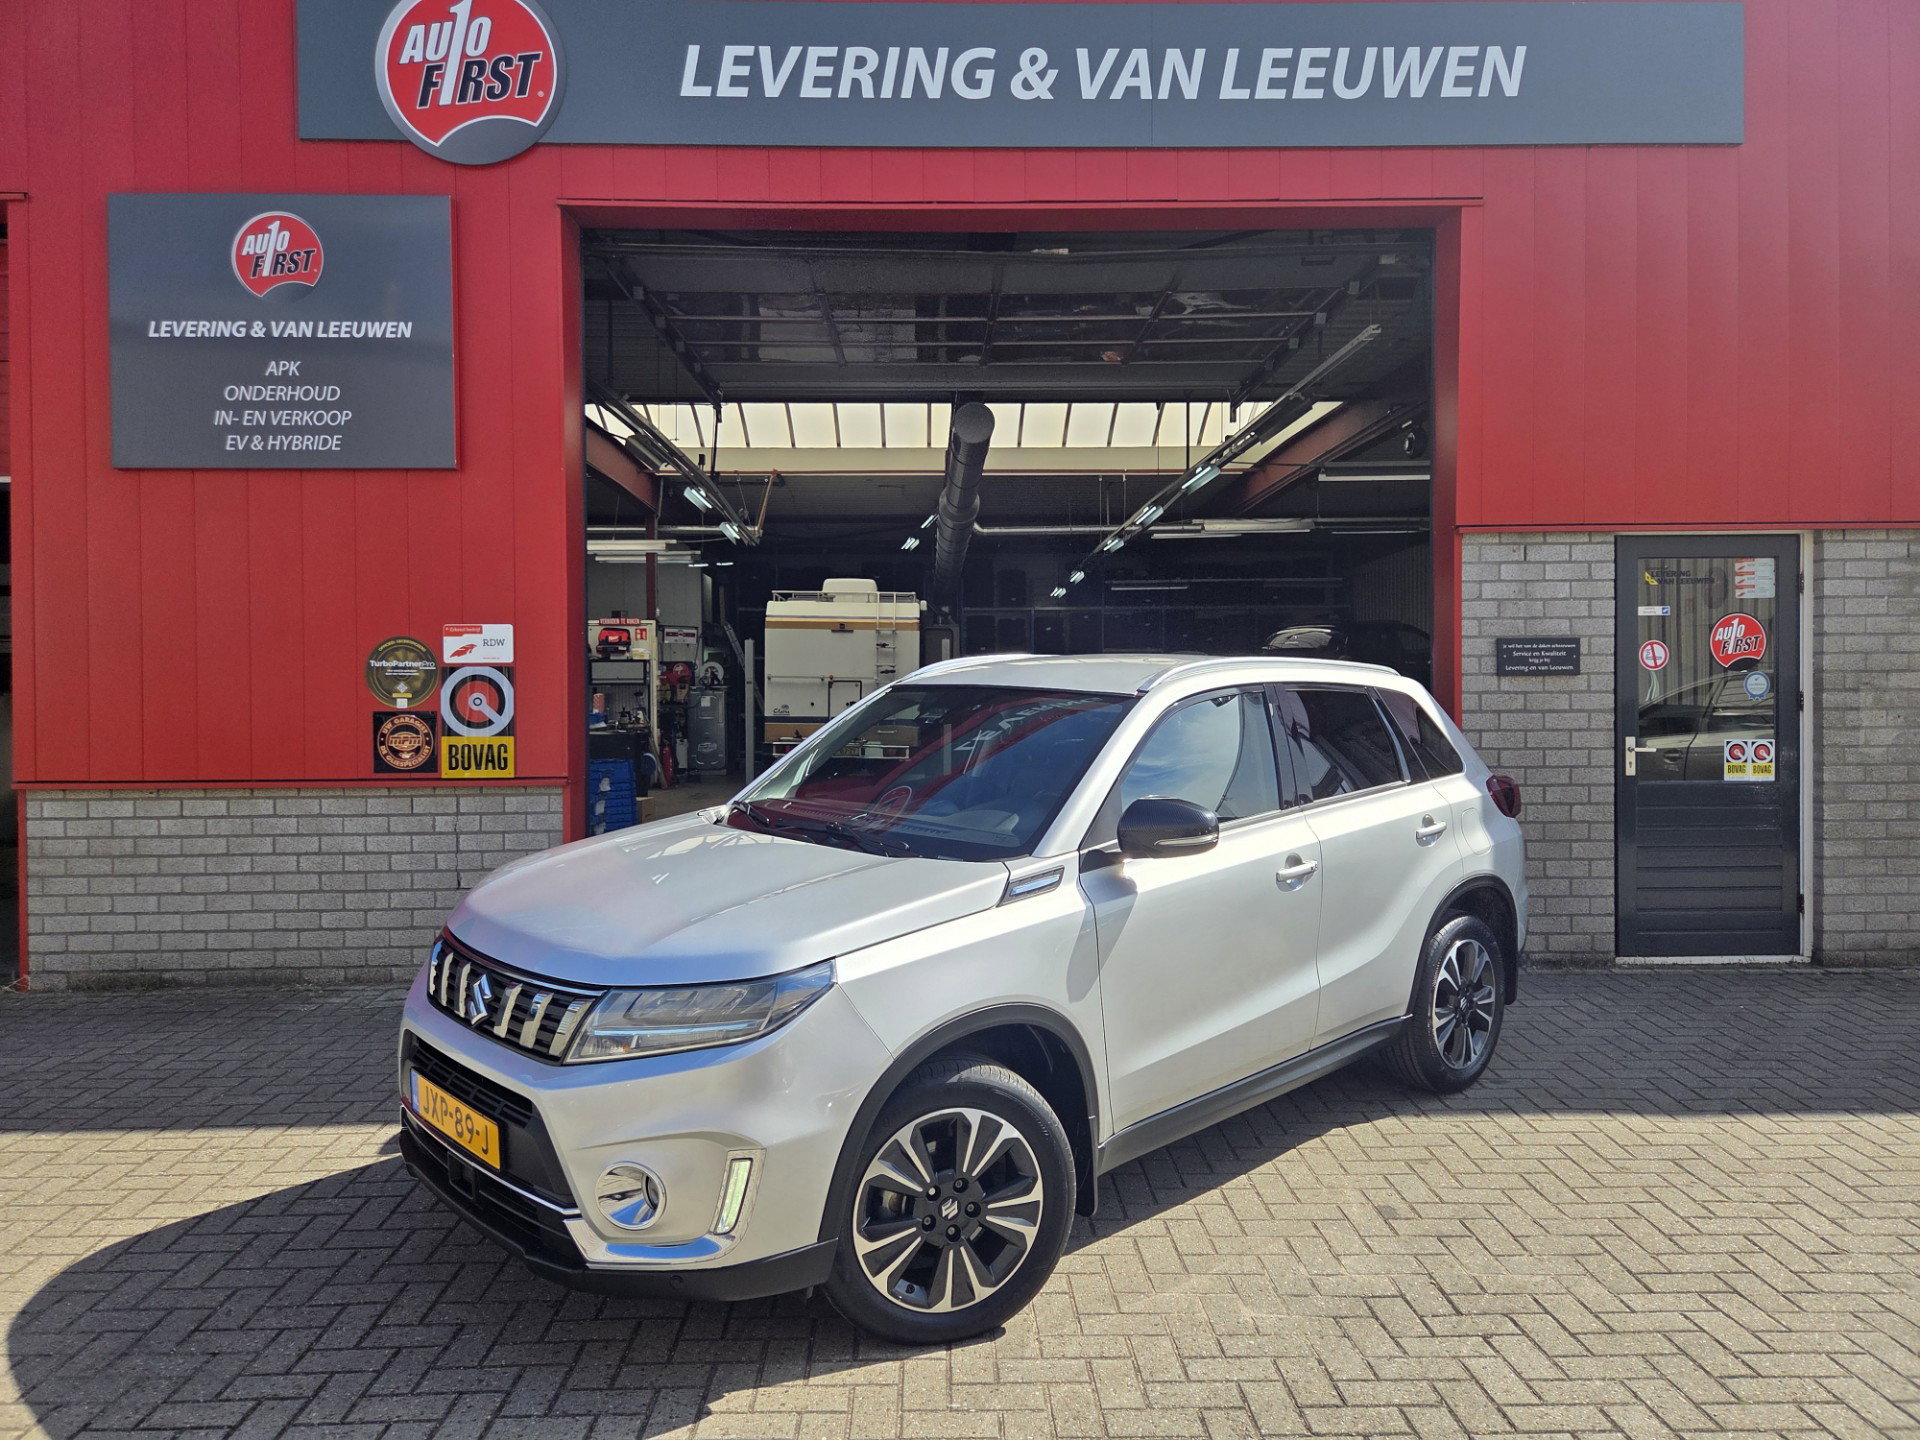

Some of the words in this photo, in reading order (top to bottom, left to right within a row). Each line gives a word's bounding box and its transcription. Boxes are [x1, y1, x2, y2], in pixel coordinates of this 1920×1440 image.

[679, 45, 996, 99] LEVERING
[1010, 47, 1059, 98] &
[1076, 48, 1206, 98] VAN
[1219, 46, 1526, 98] LEEUWEN
[148, 321, 246, 338] LEVERING
[250, 322, 265, 338] &
[271, 321, 313, 338] VAN
[317, 321, 412, 338] LEEUWEN
[265, 361, 301, 376] APK
[224, 386, 341, 401] ONDERHOUD
[214, 411, 239, 426] IN-
[243, 411, 266, 426] EN
[270, 411, 352, 426] VERKOOP
[225, 435, 248, 451] EV
[252, 436, 263, 451] &
[267, 435, 342, 451] HYBRIDE
[448, 744, 508, 771] BOVAG
[1727, 765, 1746, 774] BOVAG
[1752, 765, 1772, 774] BOVAG
[423, 1086, 489, 1155] JXP-89-J
